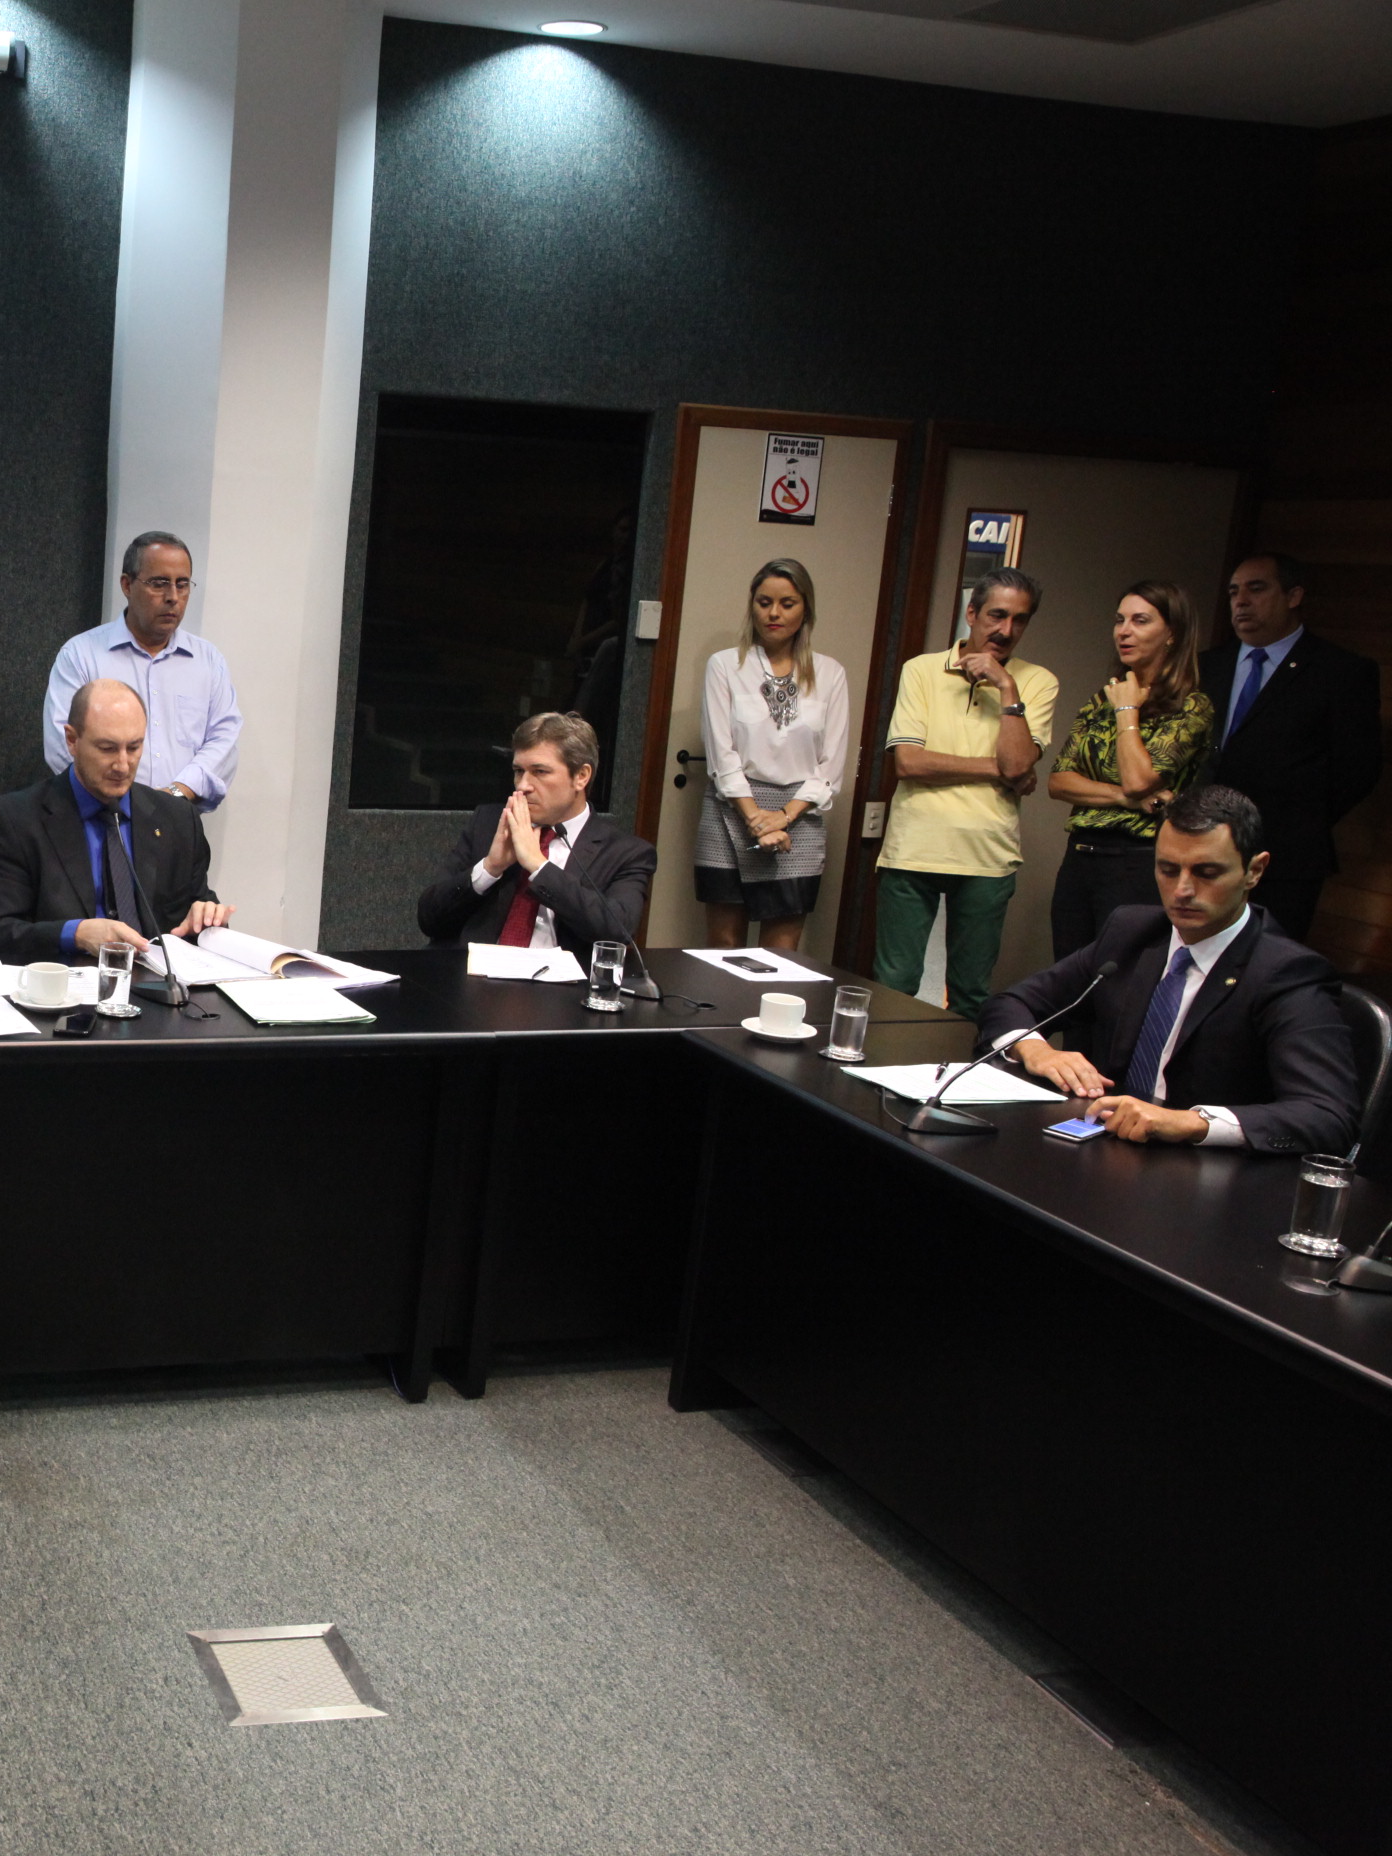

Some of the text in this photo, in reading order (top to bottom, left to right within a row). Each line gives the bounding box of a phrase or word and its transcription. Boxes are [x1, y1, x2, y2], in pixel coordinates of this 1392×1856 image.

[774, 437, 819, 448] Fumar aqui
[773, 446, 788, 454] não
[797, 447, 818, 456] legal
